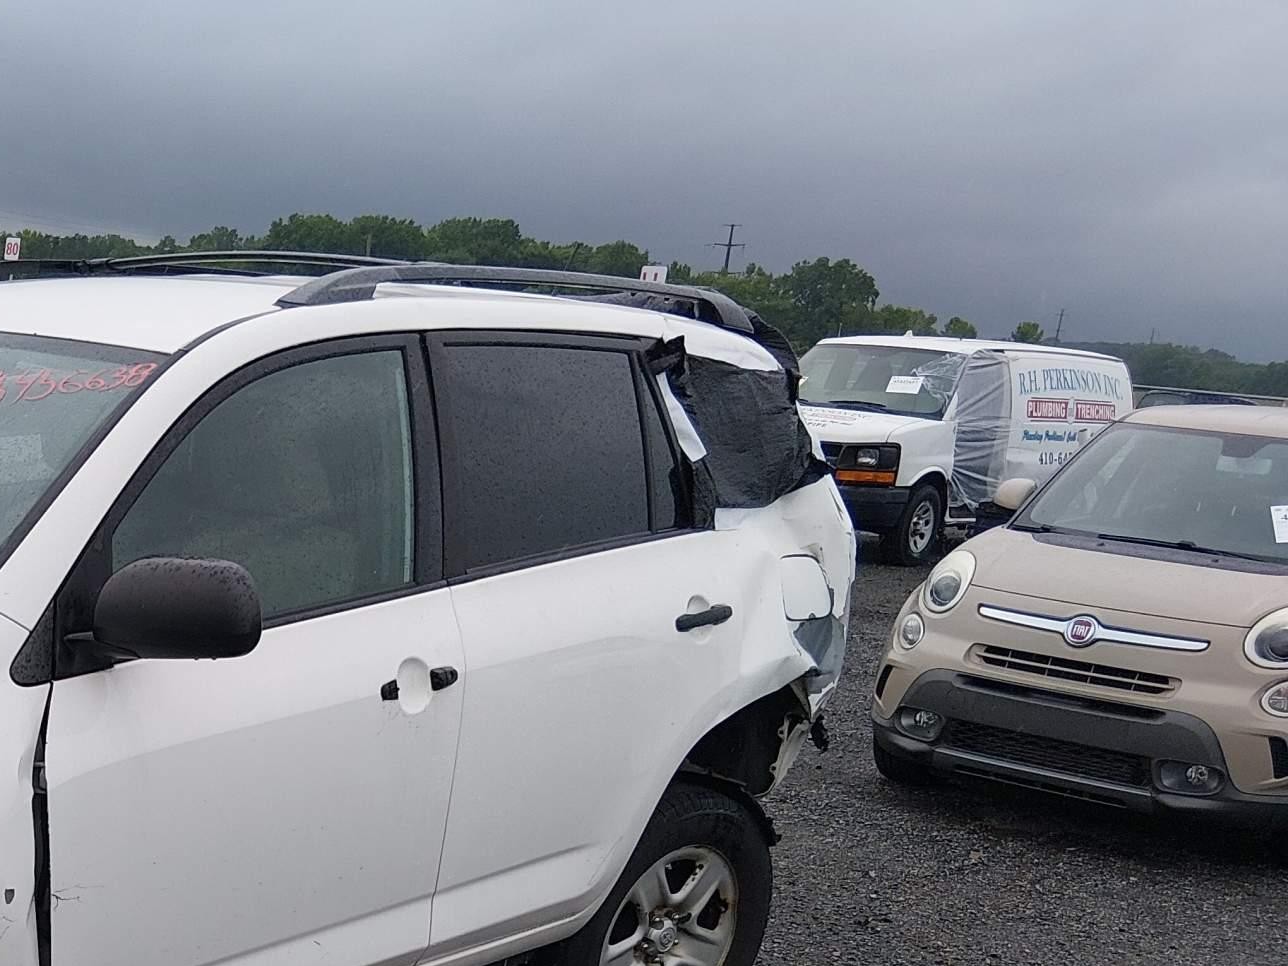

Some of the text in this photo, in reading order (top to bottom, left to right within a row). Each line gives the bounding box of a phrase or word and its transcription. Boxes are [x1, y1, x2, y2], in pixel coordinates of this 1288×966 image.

[6, 242, 19, 256] 80
[1018, 368, 1124, 400] R.H. PERKINSON INC.
[1028, 401, 1066, 417] PLUMBING
[1077, 404, 1115, 421] TRENCHING
